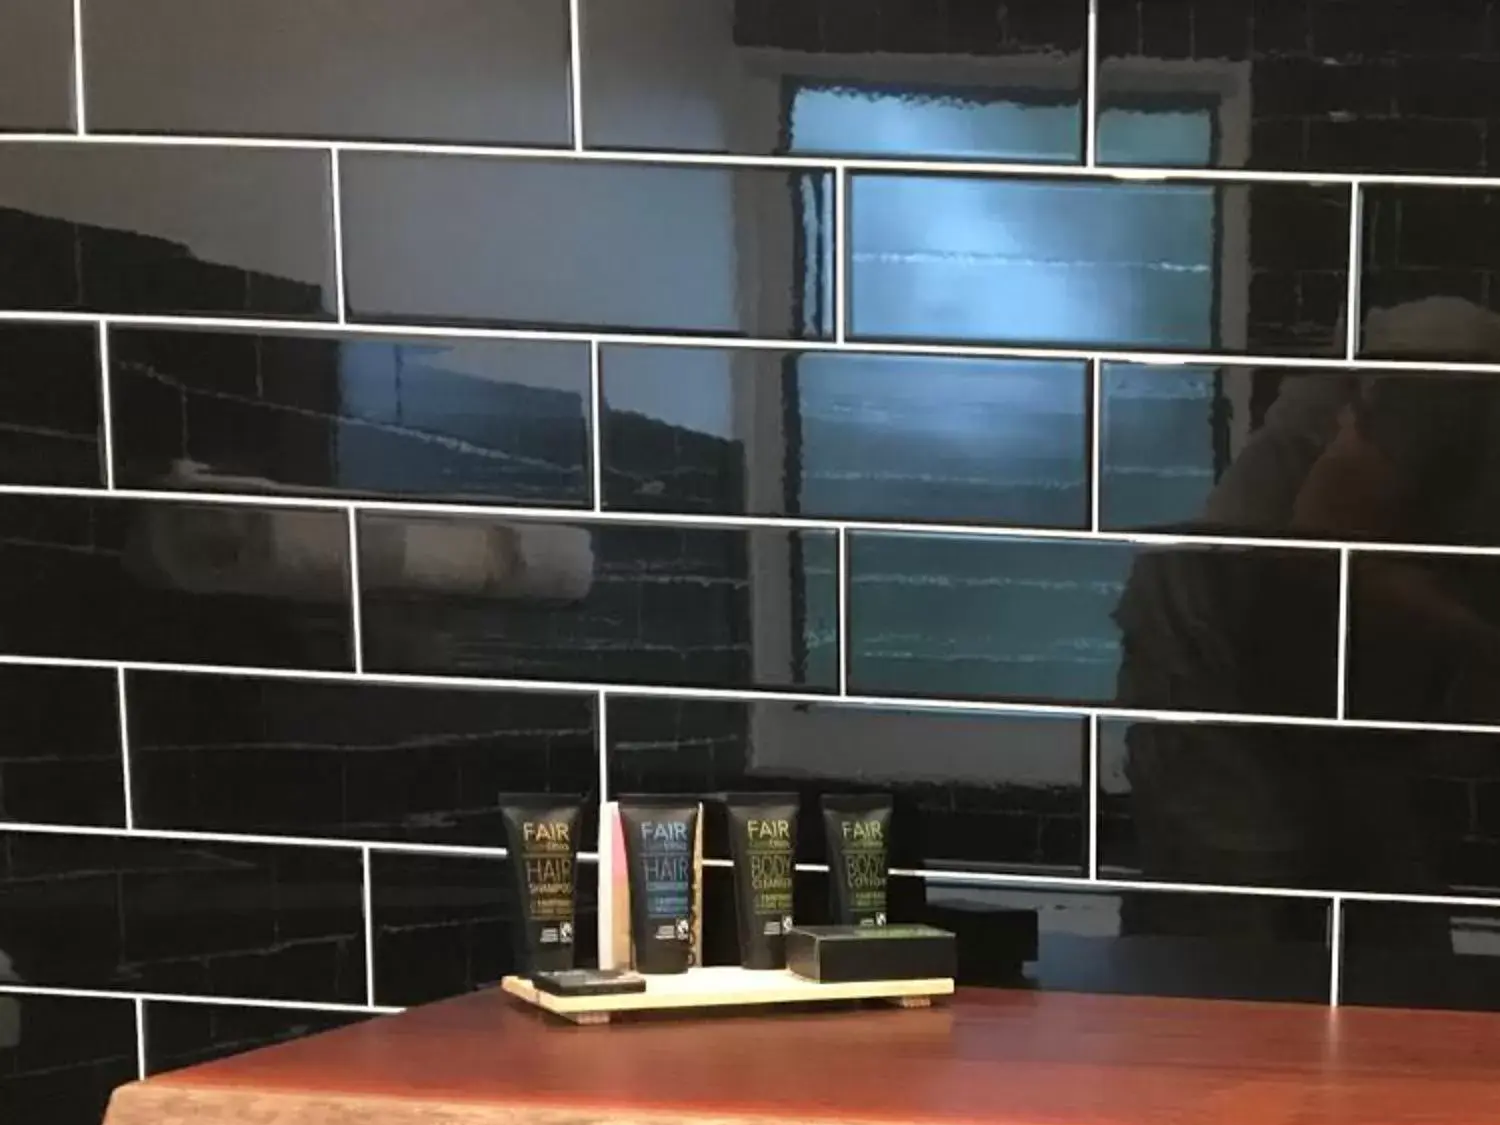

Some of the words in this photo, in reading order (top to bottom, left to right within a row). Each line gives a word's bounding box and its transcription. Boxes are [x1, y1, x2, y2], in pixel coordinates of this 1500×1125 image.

[523, 822, 570, 841] FAIR
[641, 821, 688, 840] FAIR
[747, 820, 790, 840] FAIR
[842, 821, 883, 839] FAIR
[643, 857, 689, 881] HAIR
